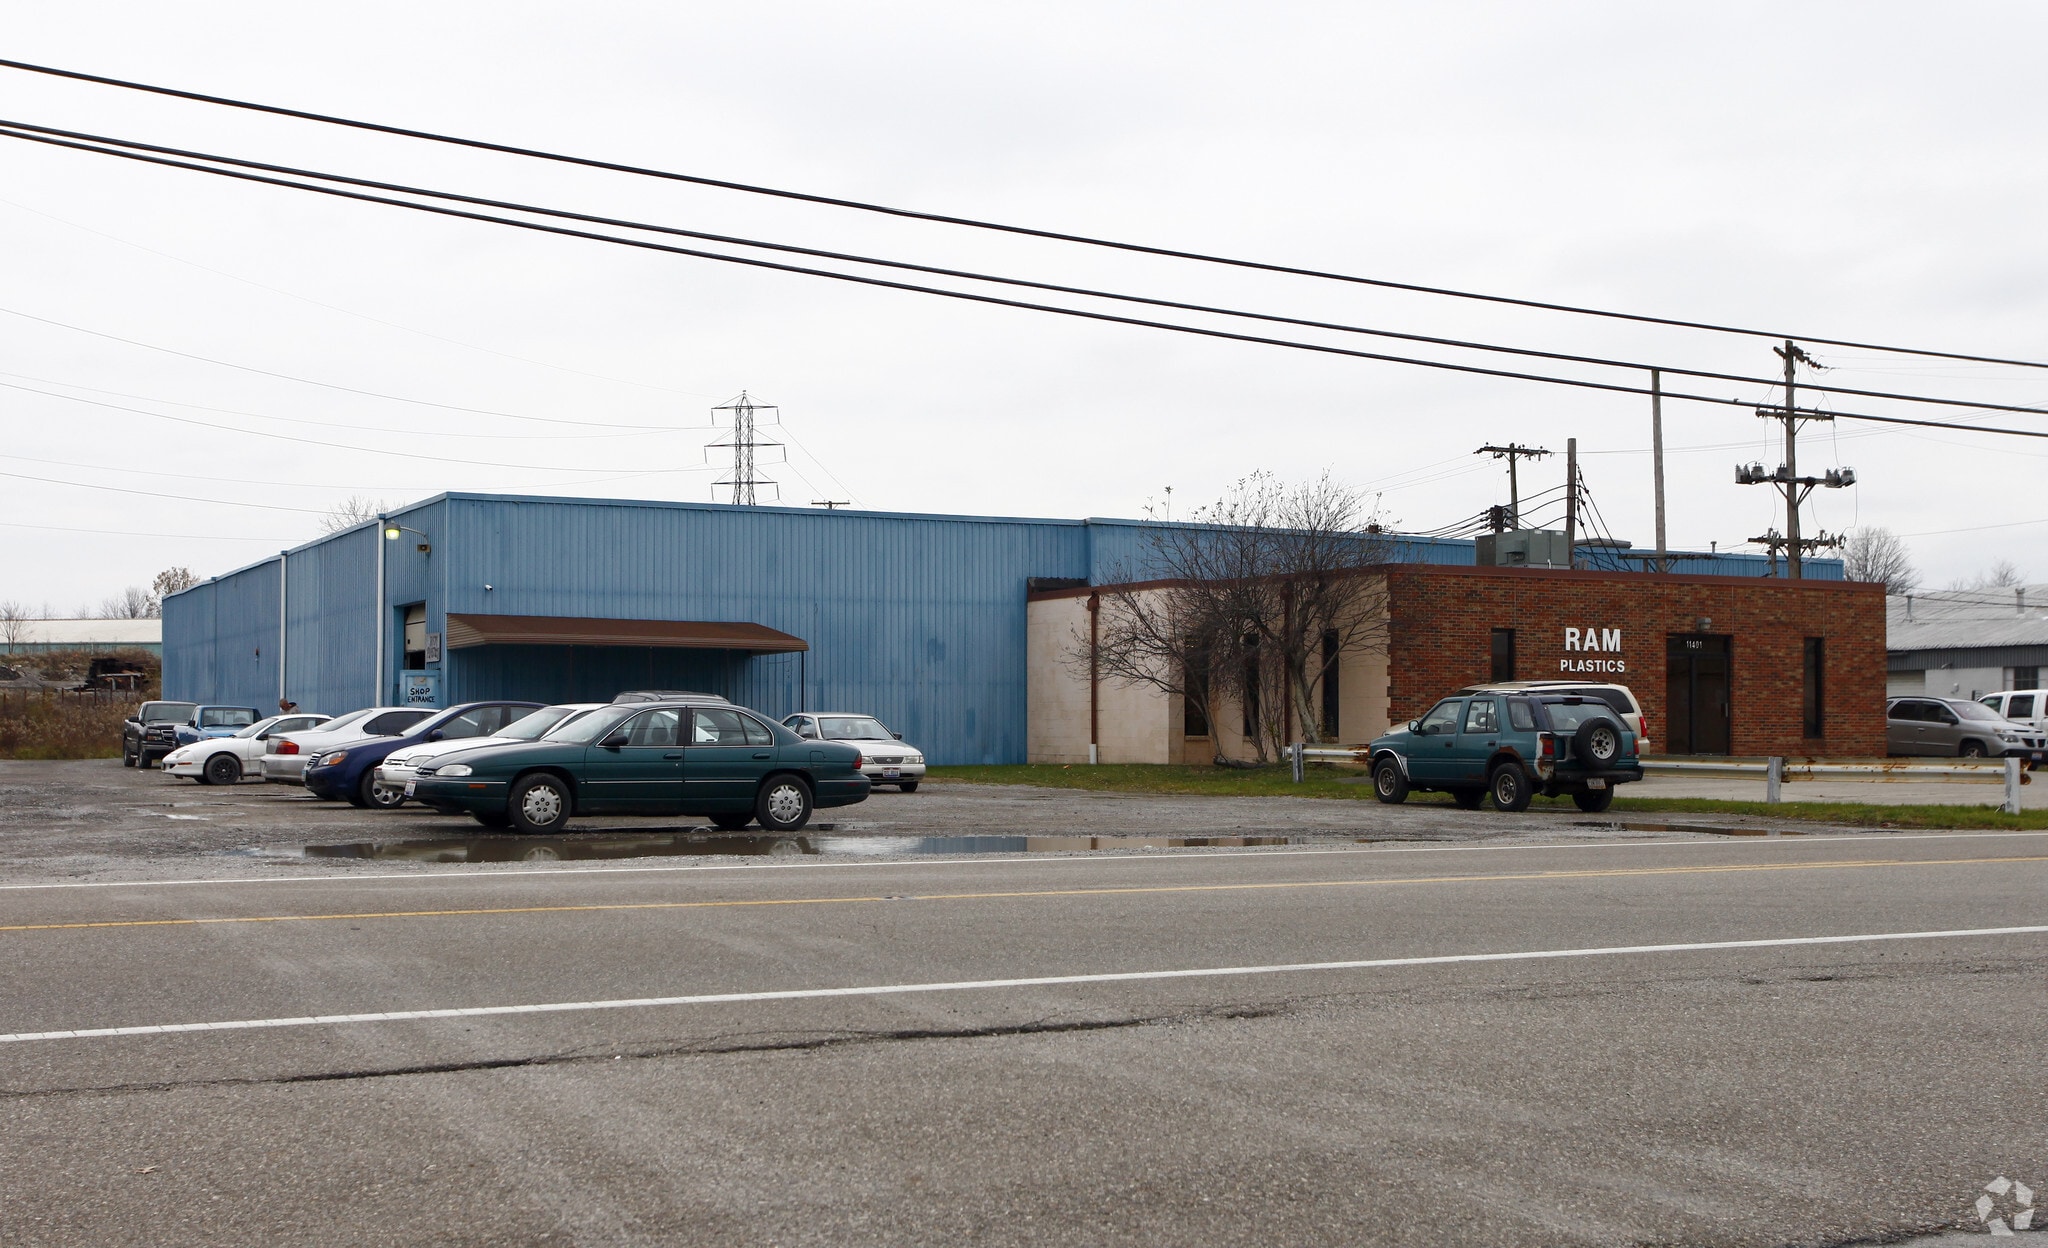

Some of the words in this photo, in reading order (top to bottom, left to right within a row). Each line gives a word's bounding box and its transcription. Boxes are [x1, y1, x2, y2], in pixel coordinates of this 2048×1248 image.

[1565, 627, 1621, 652] RAM
[1686, 640, 1703, 649] 11401
[1560, 659, 1625, 673] PLASTICS
[410, 687, 430, 695] SHOP
[407, 695, 435, 703] ENTRANCE
